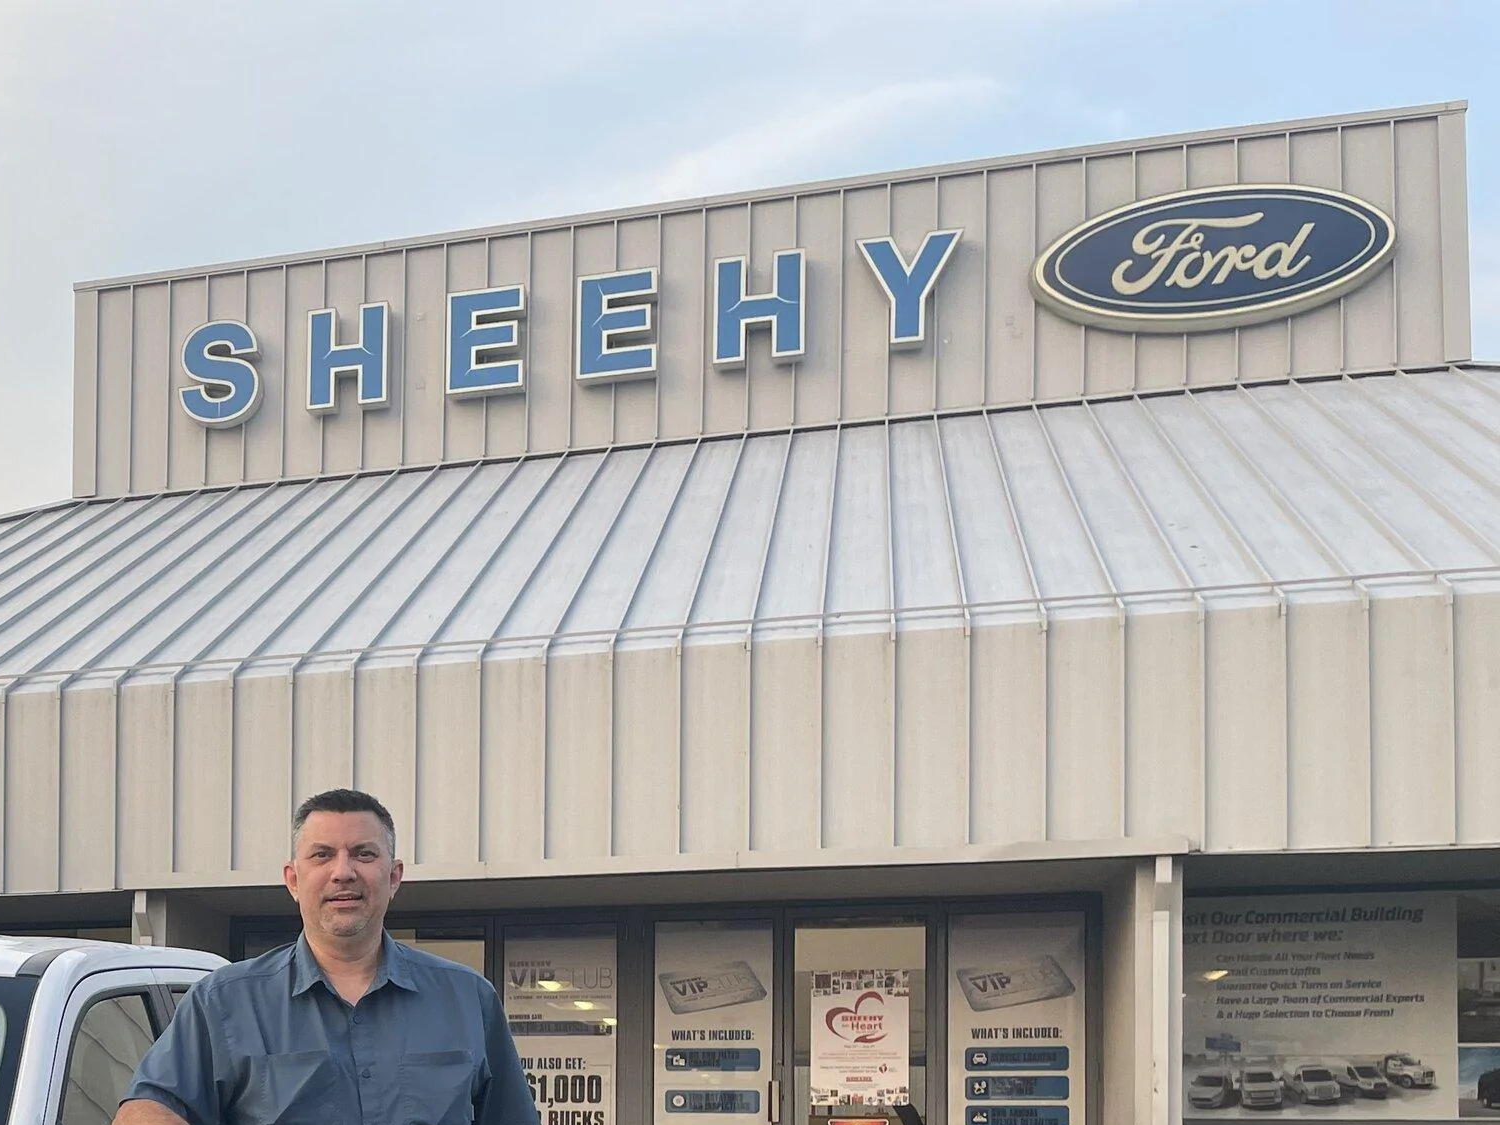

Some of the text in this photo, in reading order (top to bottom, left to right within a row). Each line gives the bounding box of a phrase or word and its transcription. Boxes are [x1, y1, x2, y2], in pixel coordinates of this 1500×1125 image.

[1112, 212, 1314, 295] Ford
[179, 228, 964, 428] SHEEHY
[1184, 905, 1425, 926] sit Our Commercial Building
[1184, 928, 1344, 945] ext Door where we:
[672, 980, 708, 996] VIP
[971, 975, 1011, 992] VIP
[1344, 979, 1382, 989] Service
[1323, 994, 1384, 1003] Commercial
[1385, 993, 1425, 1004] Experts
[852, 1021, 883, 1031] Heart
[971, 1027, 1063, 1039] WHAT'S INCLUDED:
[672, 1030, 755, 1041] WHAT'S INCLUDED:
[520, 1057, 586, 1069] OU ALSO GET:
